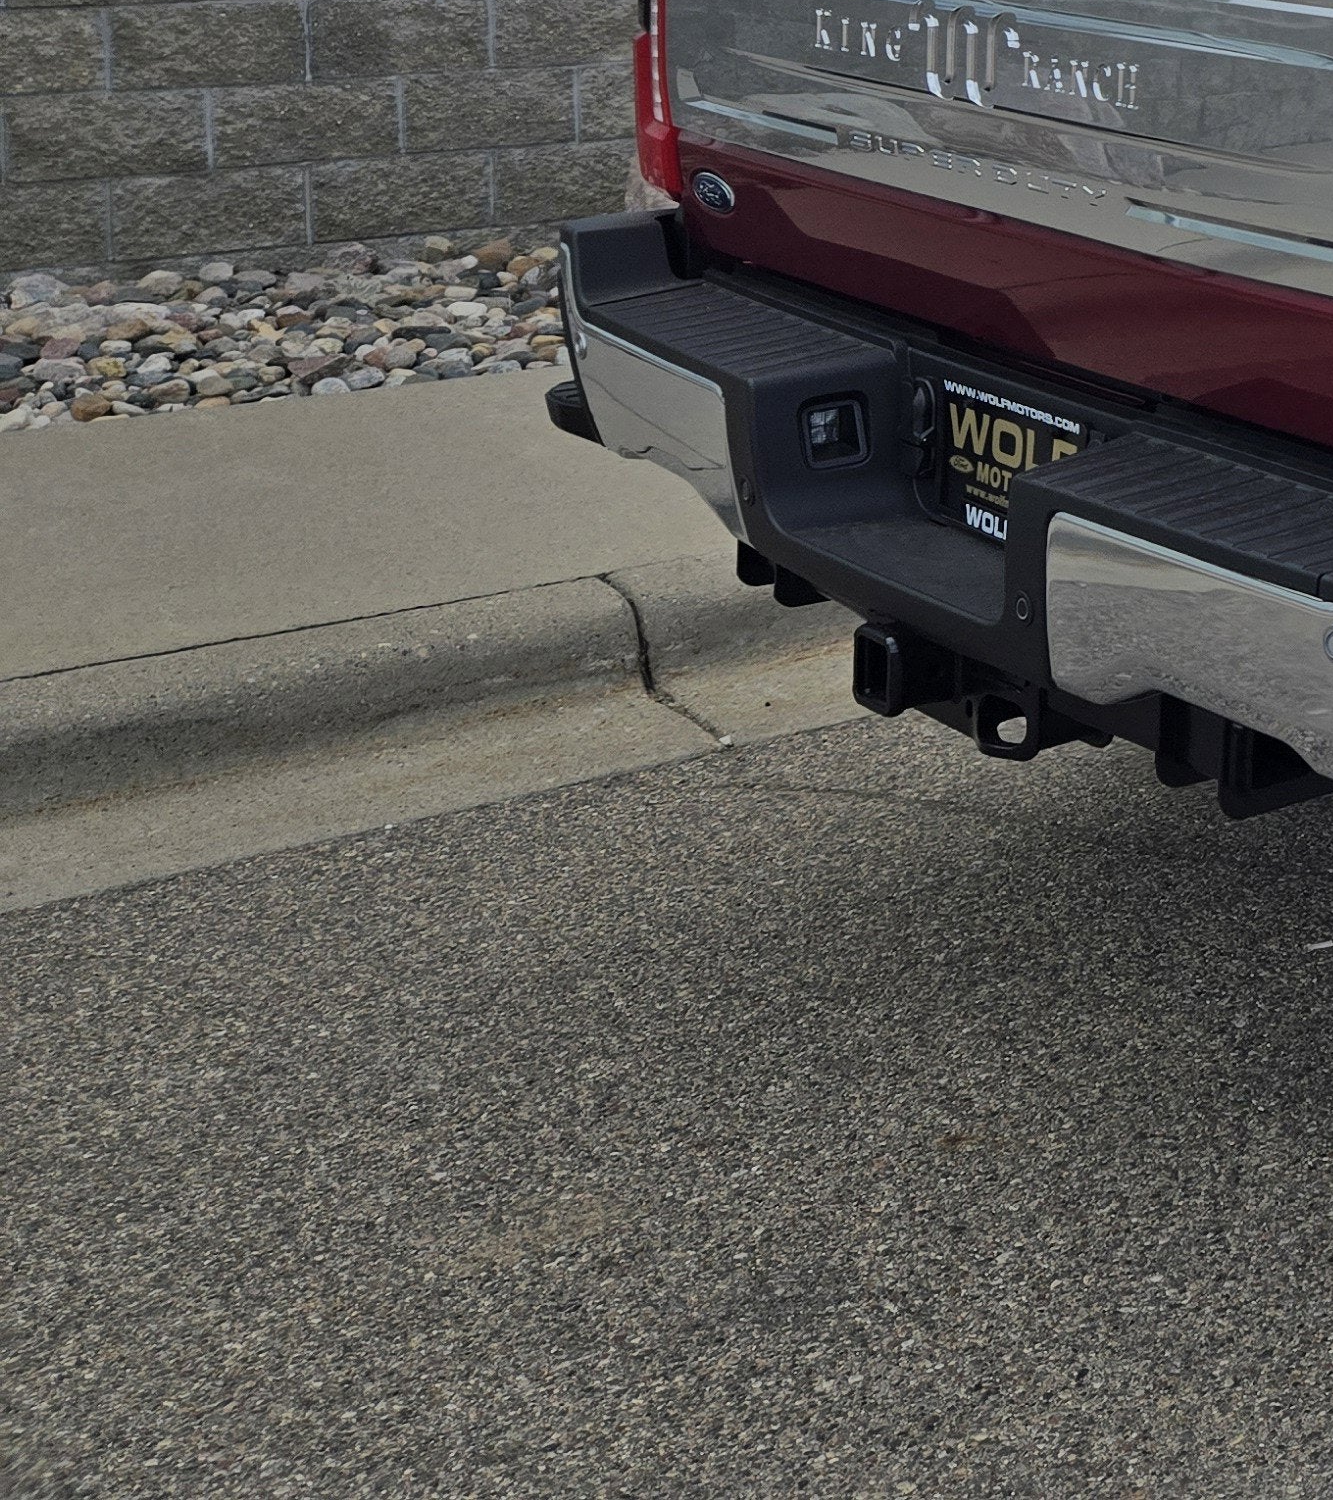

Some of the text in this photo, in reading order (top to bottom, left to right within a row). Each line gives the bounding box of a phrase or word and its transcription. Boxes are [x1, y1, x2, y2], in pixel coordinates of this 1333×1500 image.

[814, 8, 1140, 111] KING RANCH
[850, 130, 982, 178] SUPER
[975, 461, 1013, 492] MOT
